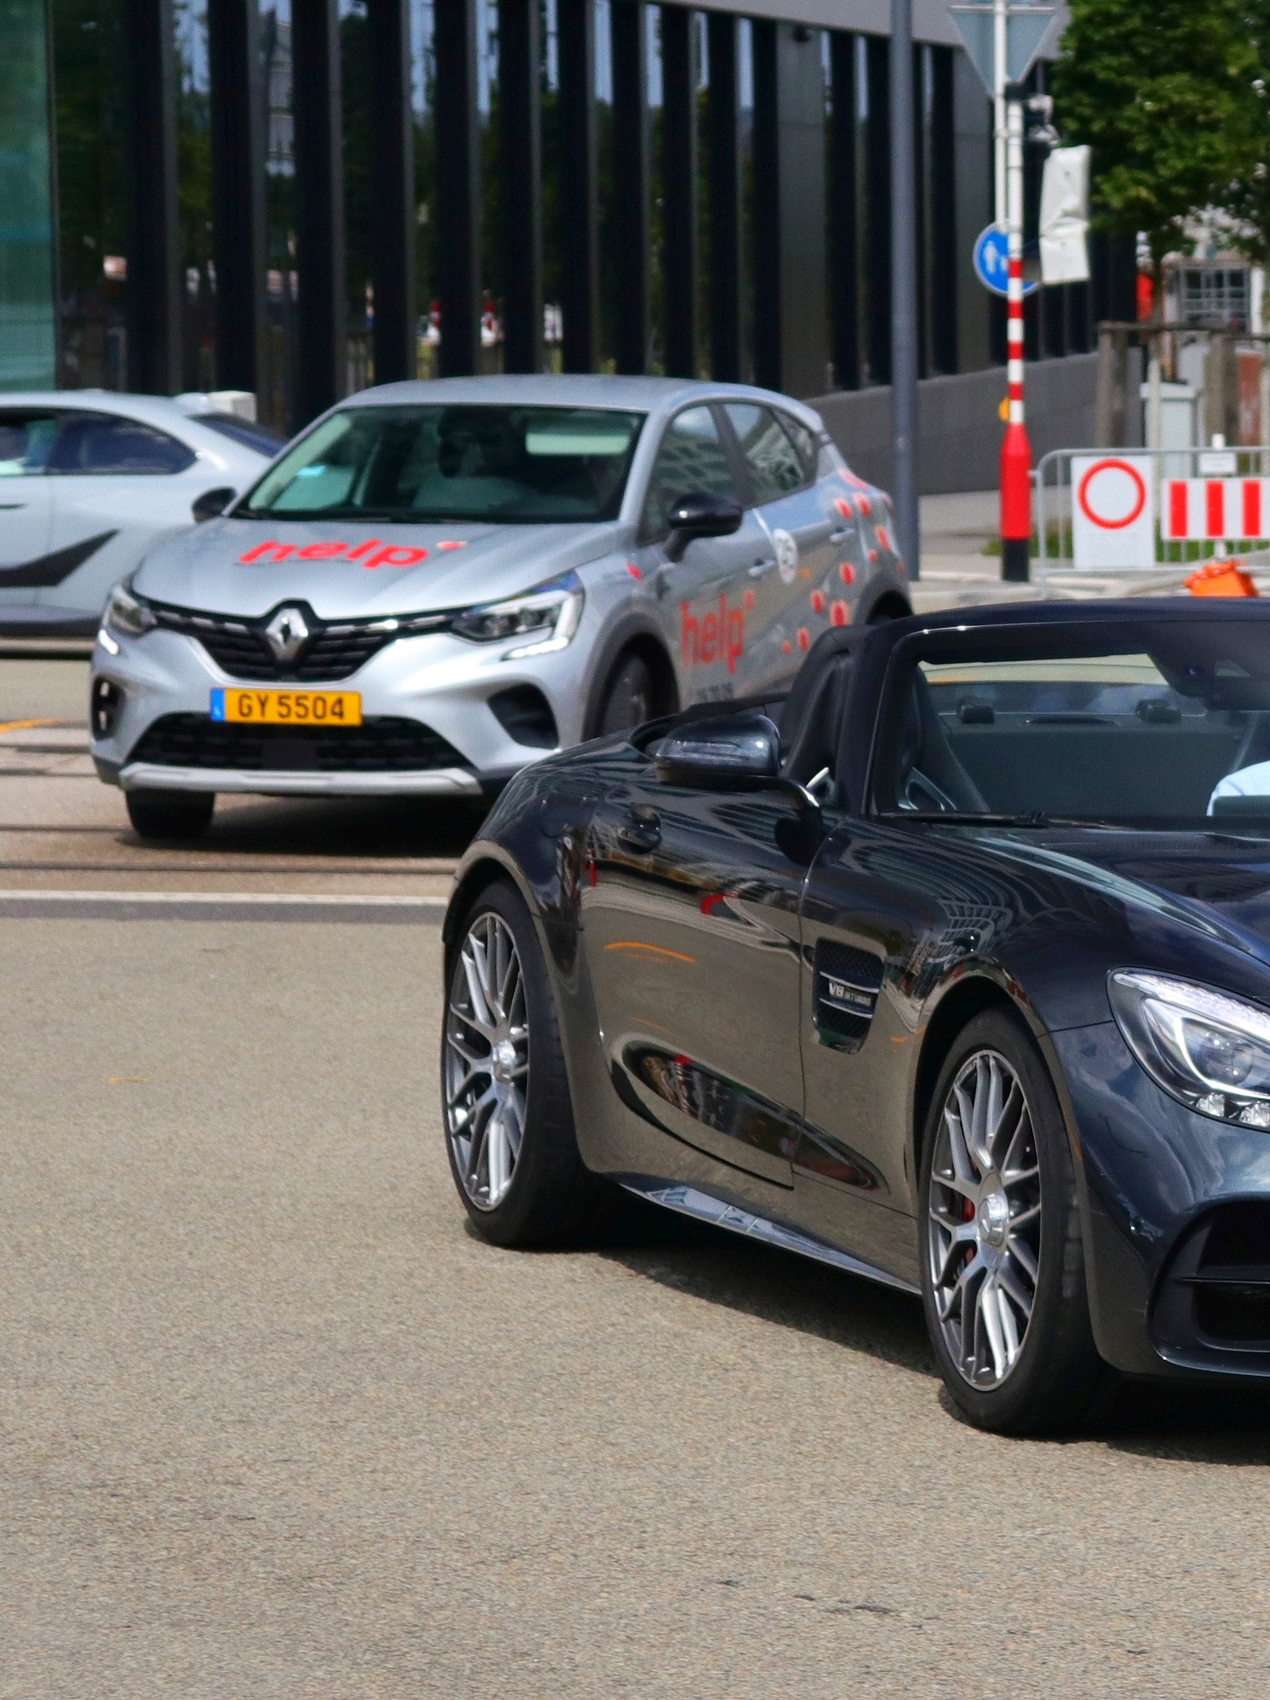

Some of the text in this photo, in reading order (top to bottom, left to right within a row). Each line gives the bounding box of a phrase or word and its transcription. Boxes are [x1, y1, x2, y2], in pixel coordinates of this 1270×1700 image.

[237, 539, 430, 569] help
[680, 592, 744, 675] help
[238, 693, 346, 720] GY 5504
